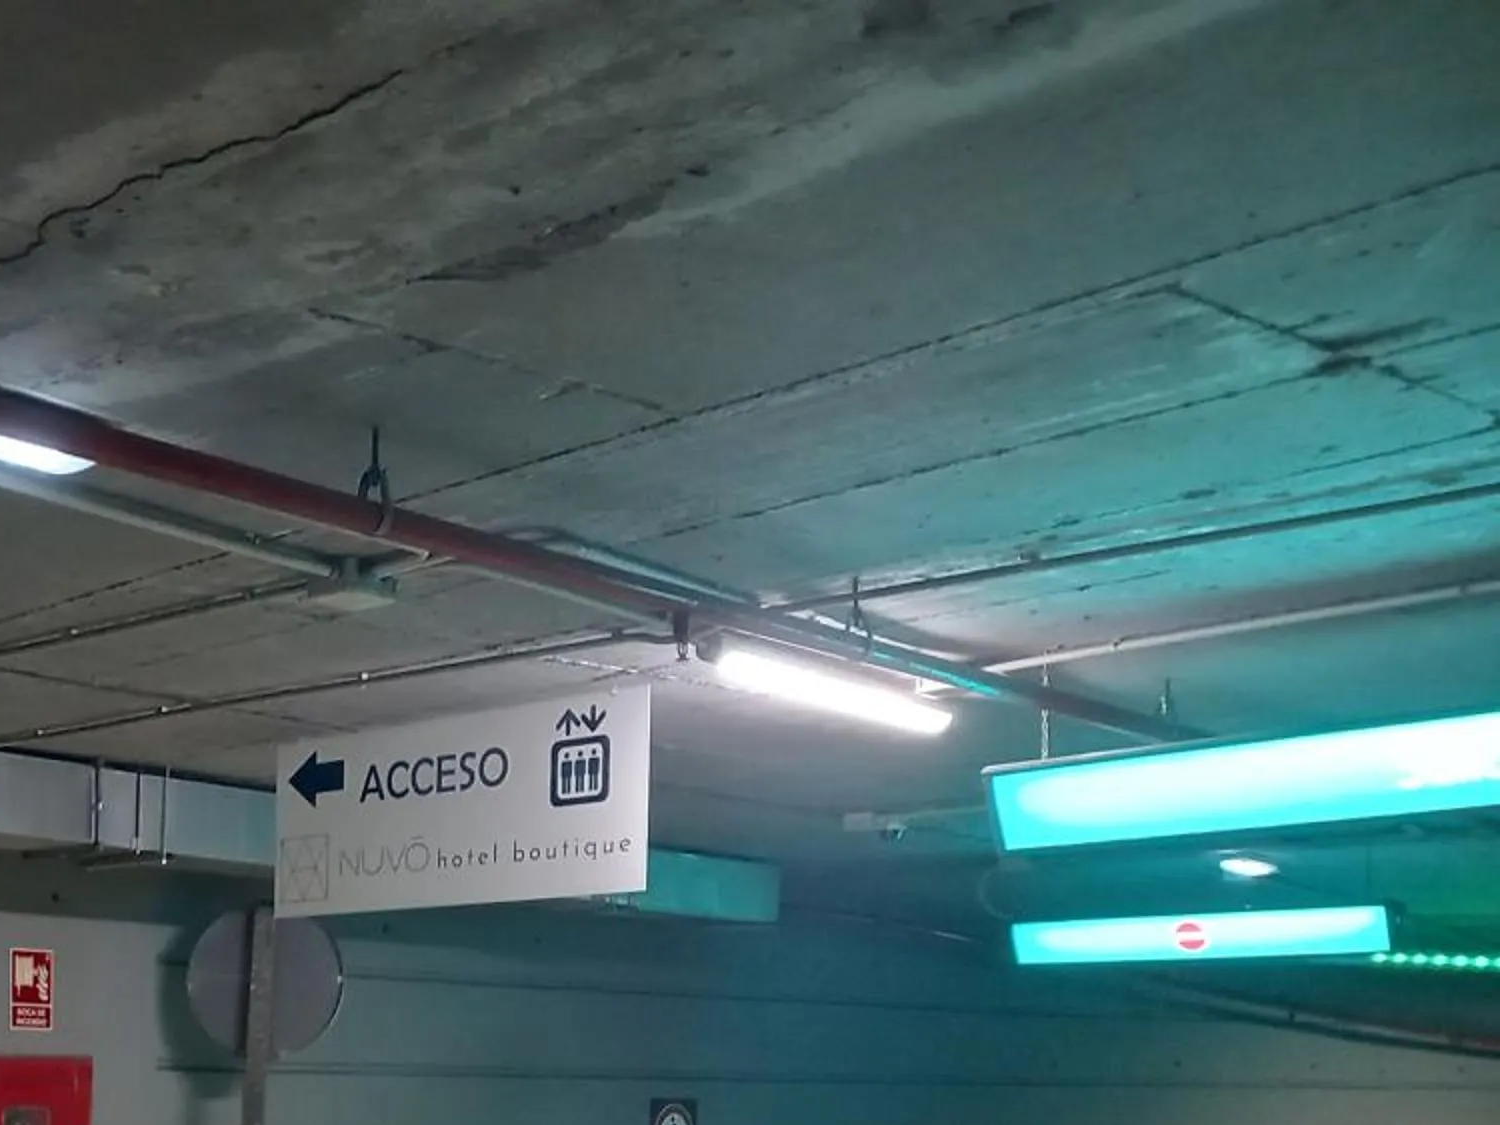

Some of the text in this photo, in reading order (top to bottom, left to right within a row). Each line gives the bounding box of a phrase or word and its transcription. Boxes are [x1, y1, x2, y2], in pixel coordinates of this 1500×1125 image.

[359, 747, 509, 802] ACCESO
[436, 844, 498, 869] hotel
[513, 836, 632, 863] boutique
